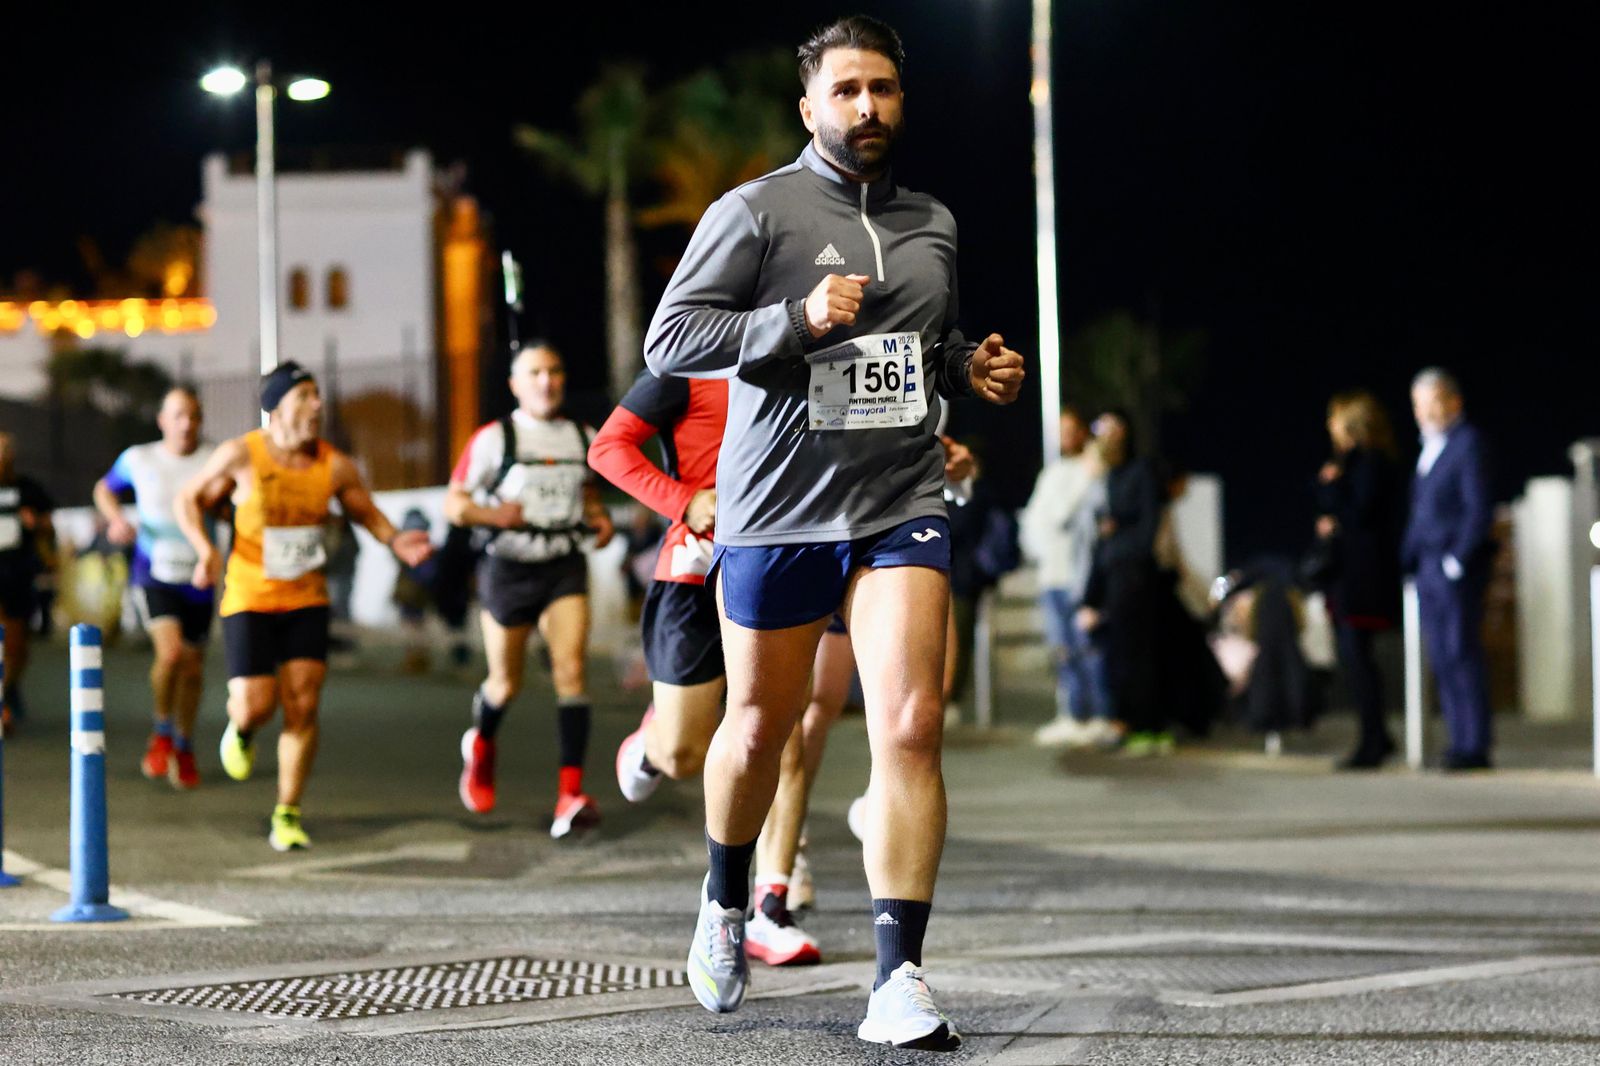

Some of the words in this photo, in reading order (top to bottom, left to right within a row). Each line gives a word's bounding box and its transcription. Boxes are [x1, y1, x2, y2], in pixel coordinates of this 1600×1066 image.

[814, 256, 846, 265] adidas
[883, 338, 898, 354] M
[842, 360, 901, 394] 156
[848, 397, 877, 405] ANTONIO
[850, 406, 887, 416] mayoral
